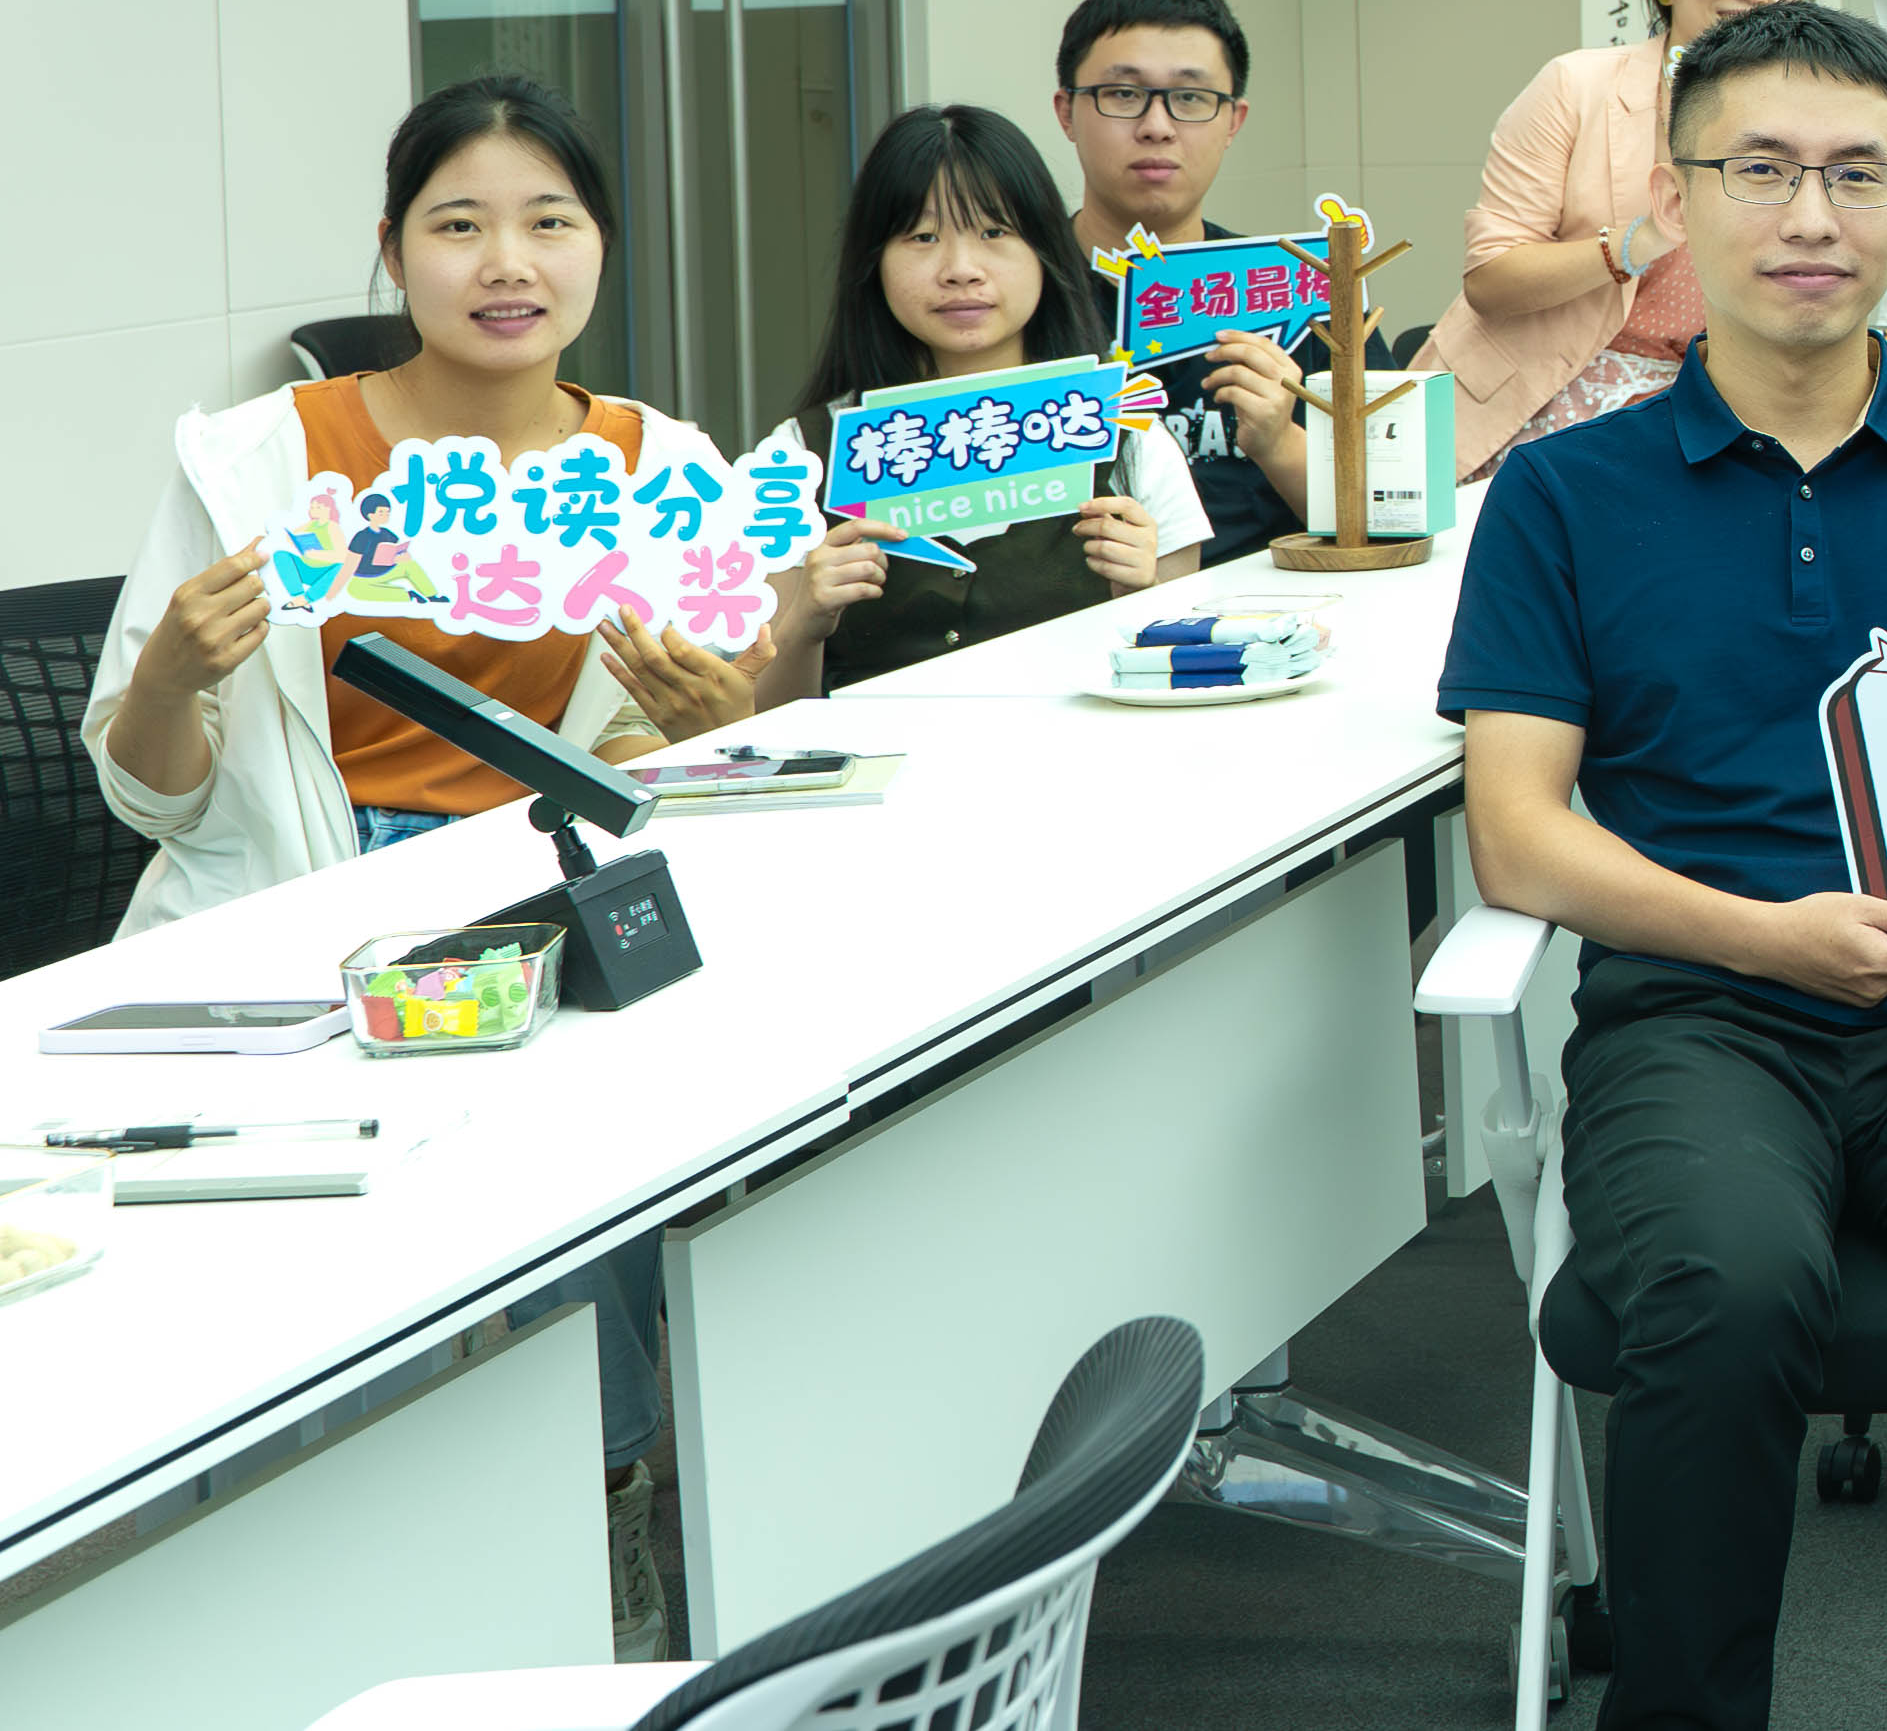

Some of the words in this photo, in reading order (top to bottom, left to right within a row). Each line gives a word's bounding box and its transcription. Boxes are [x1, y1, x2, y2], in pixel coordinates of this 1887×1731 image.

[847, 389, 1113, 488] 棒棒哒
[391, 447, 812, 559] 悦读分享
[889, 491, 972, 531] nice
[984, 475, 1068, 516] nice
[450, 539, 763, 639] 达人奖
